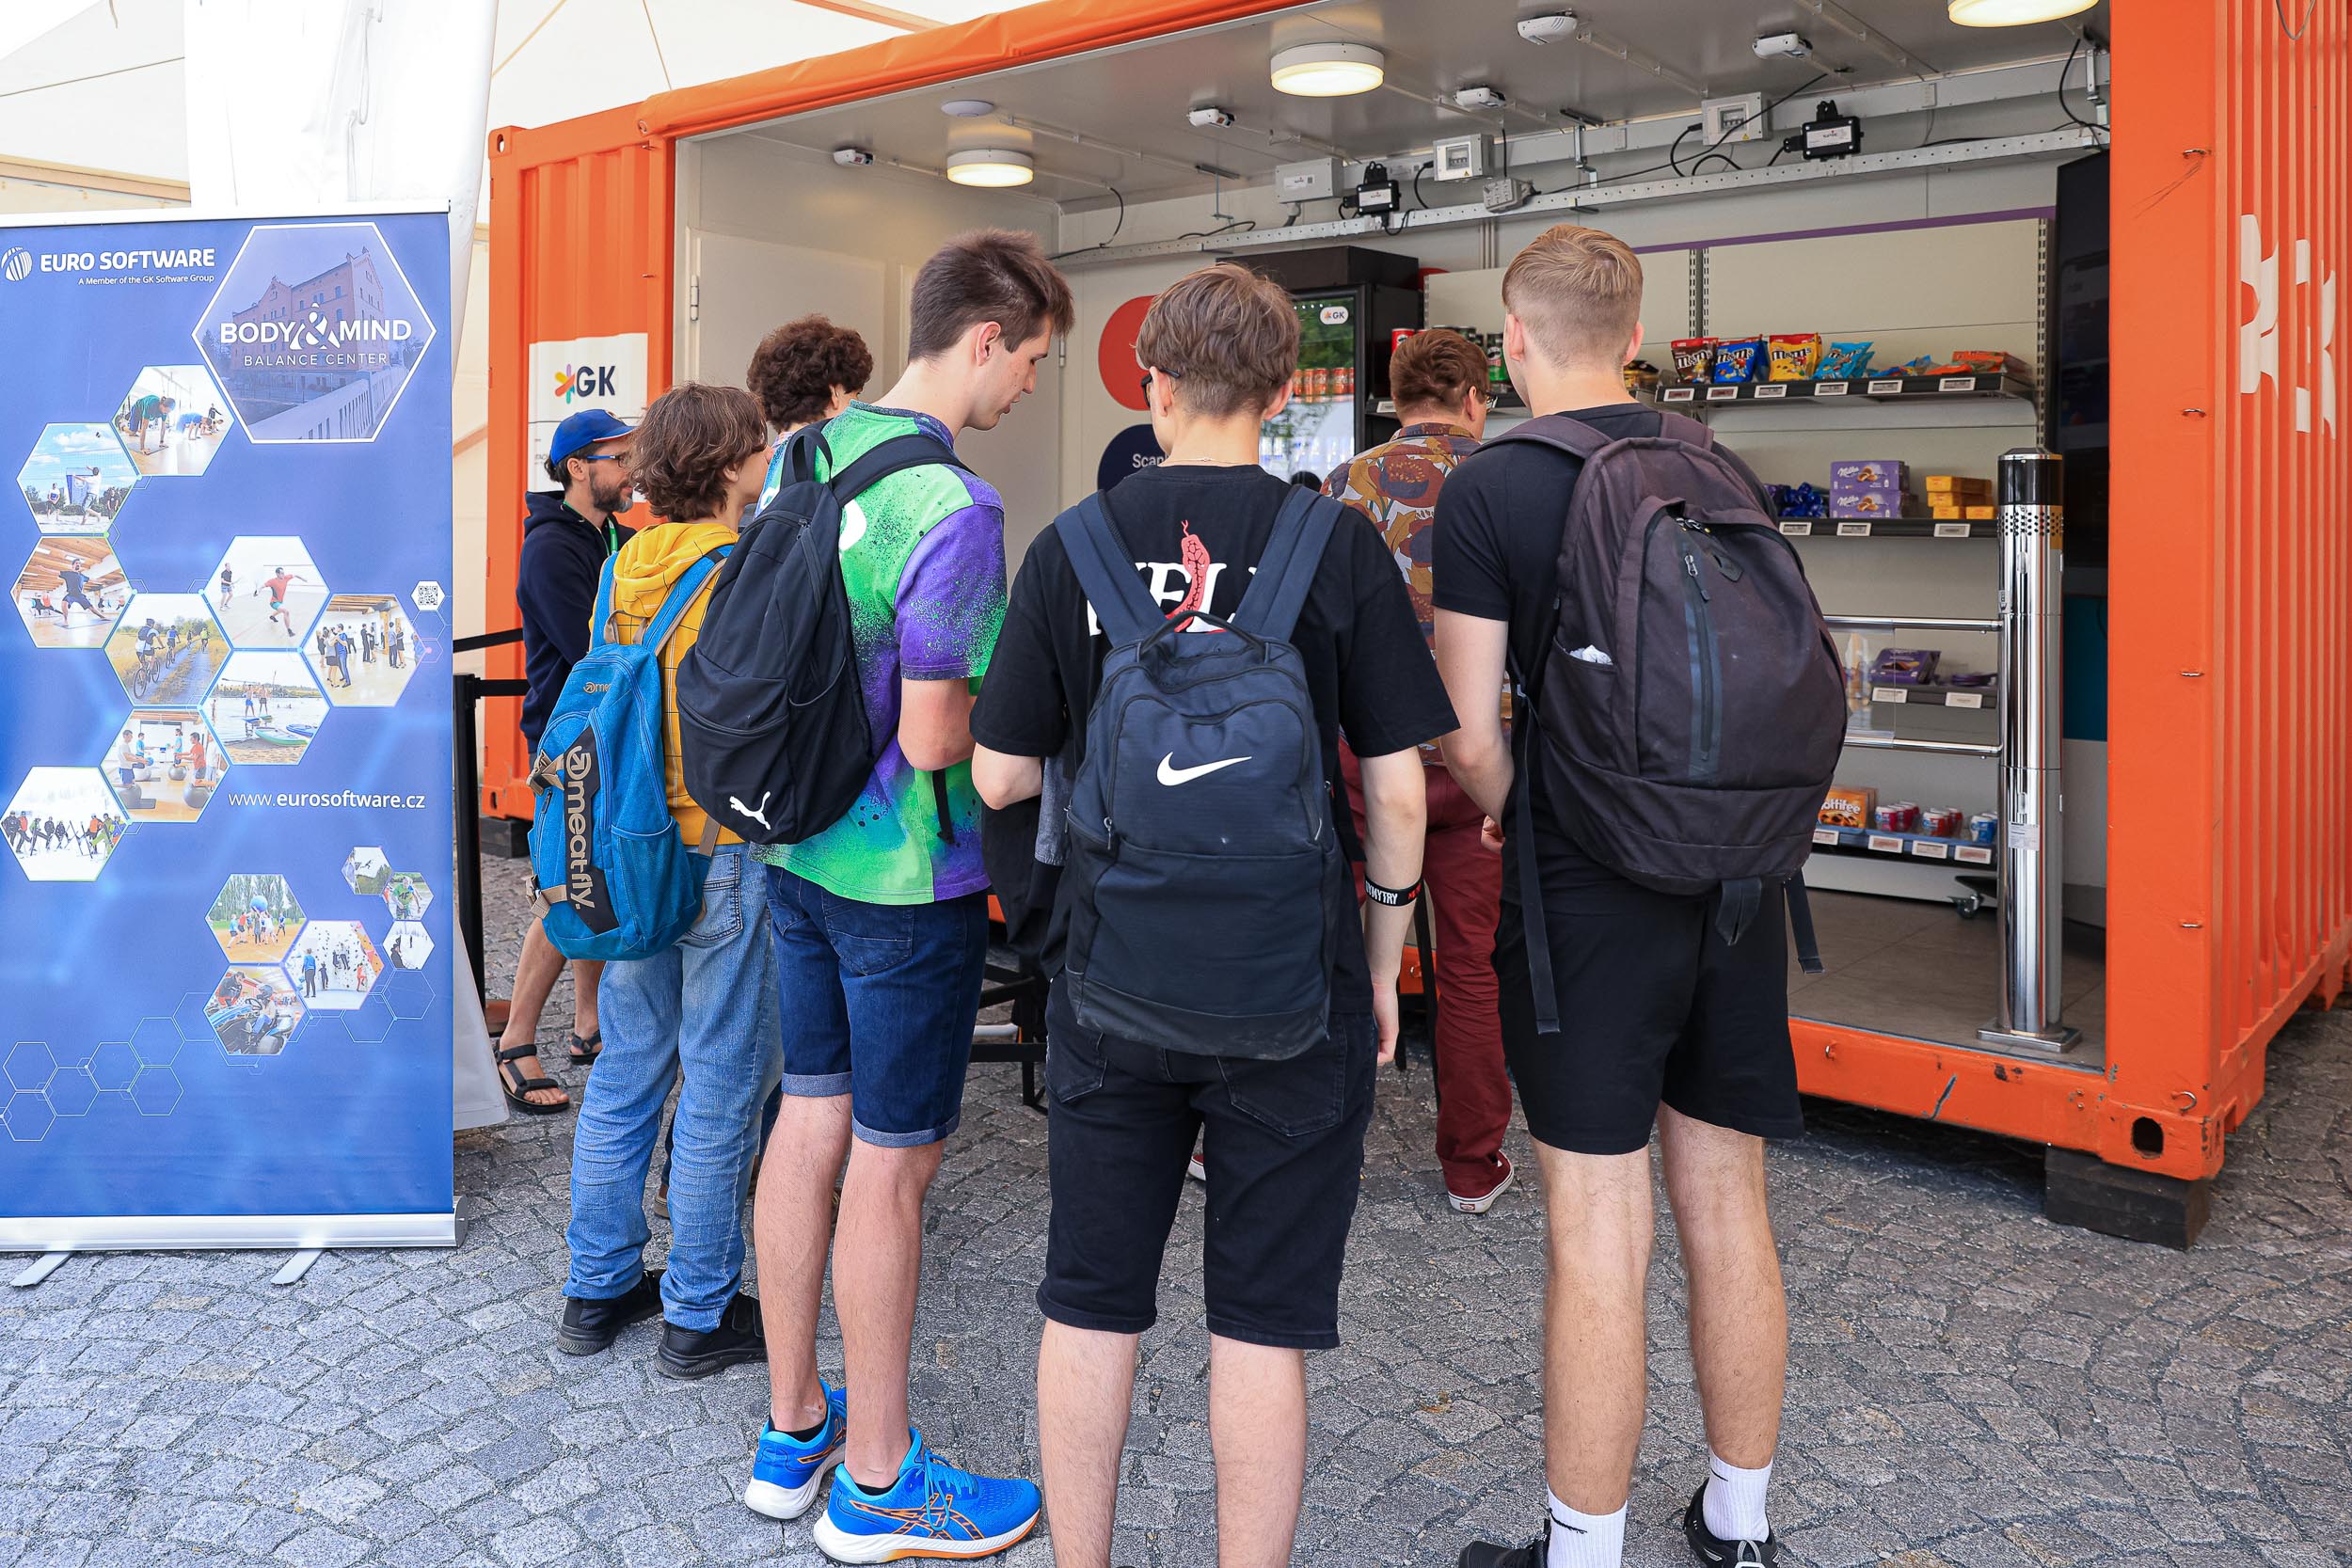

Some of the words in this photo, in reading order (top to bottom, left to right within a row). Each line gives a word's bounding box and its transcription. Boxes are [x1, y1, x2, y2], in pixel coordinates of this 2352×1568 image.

[40, 252, 95, 273] EURO
[99, 248, 215, 270] SOFTWARE
[78, 277, 85, 286] A
[86, 277, 118, 286] Member
[119, 276, 128, 284] of
[128, 276, 141, 284] the
[142, 275, 155, 284] GK
[155, 274, 189, 284] Software
[189, 274, 215, 284] Group
[1332, 311, 1345, 320] GK
[220, 321, 295, 343] BODY
[339, 319, 413, 341] MIND
[244, 354, 318, 367] BALANCE
[326, 353, 388, 366] CENTER
[576, 365, 616, 398] GK
[228, 790, 426, 809] www.eurosoftware.cz
